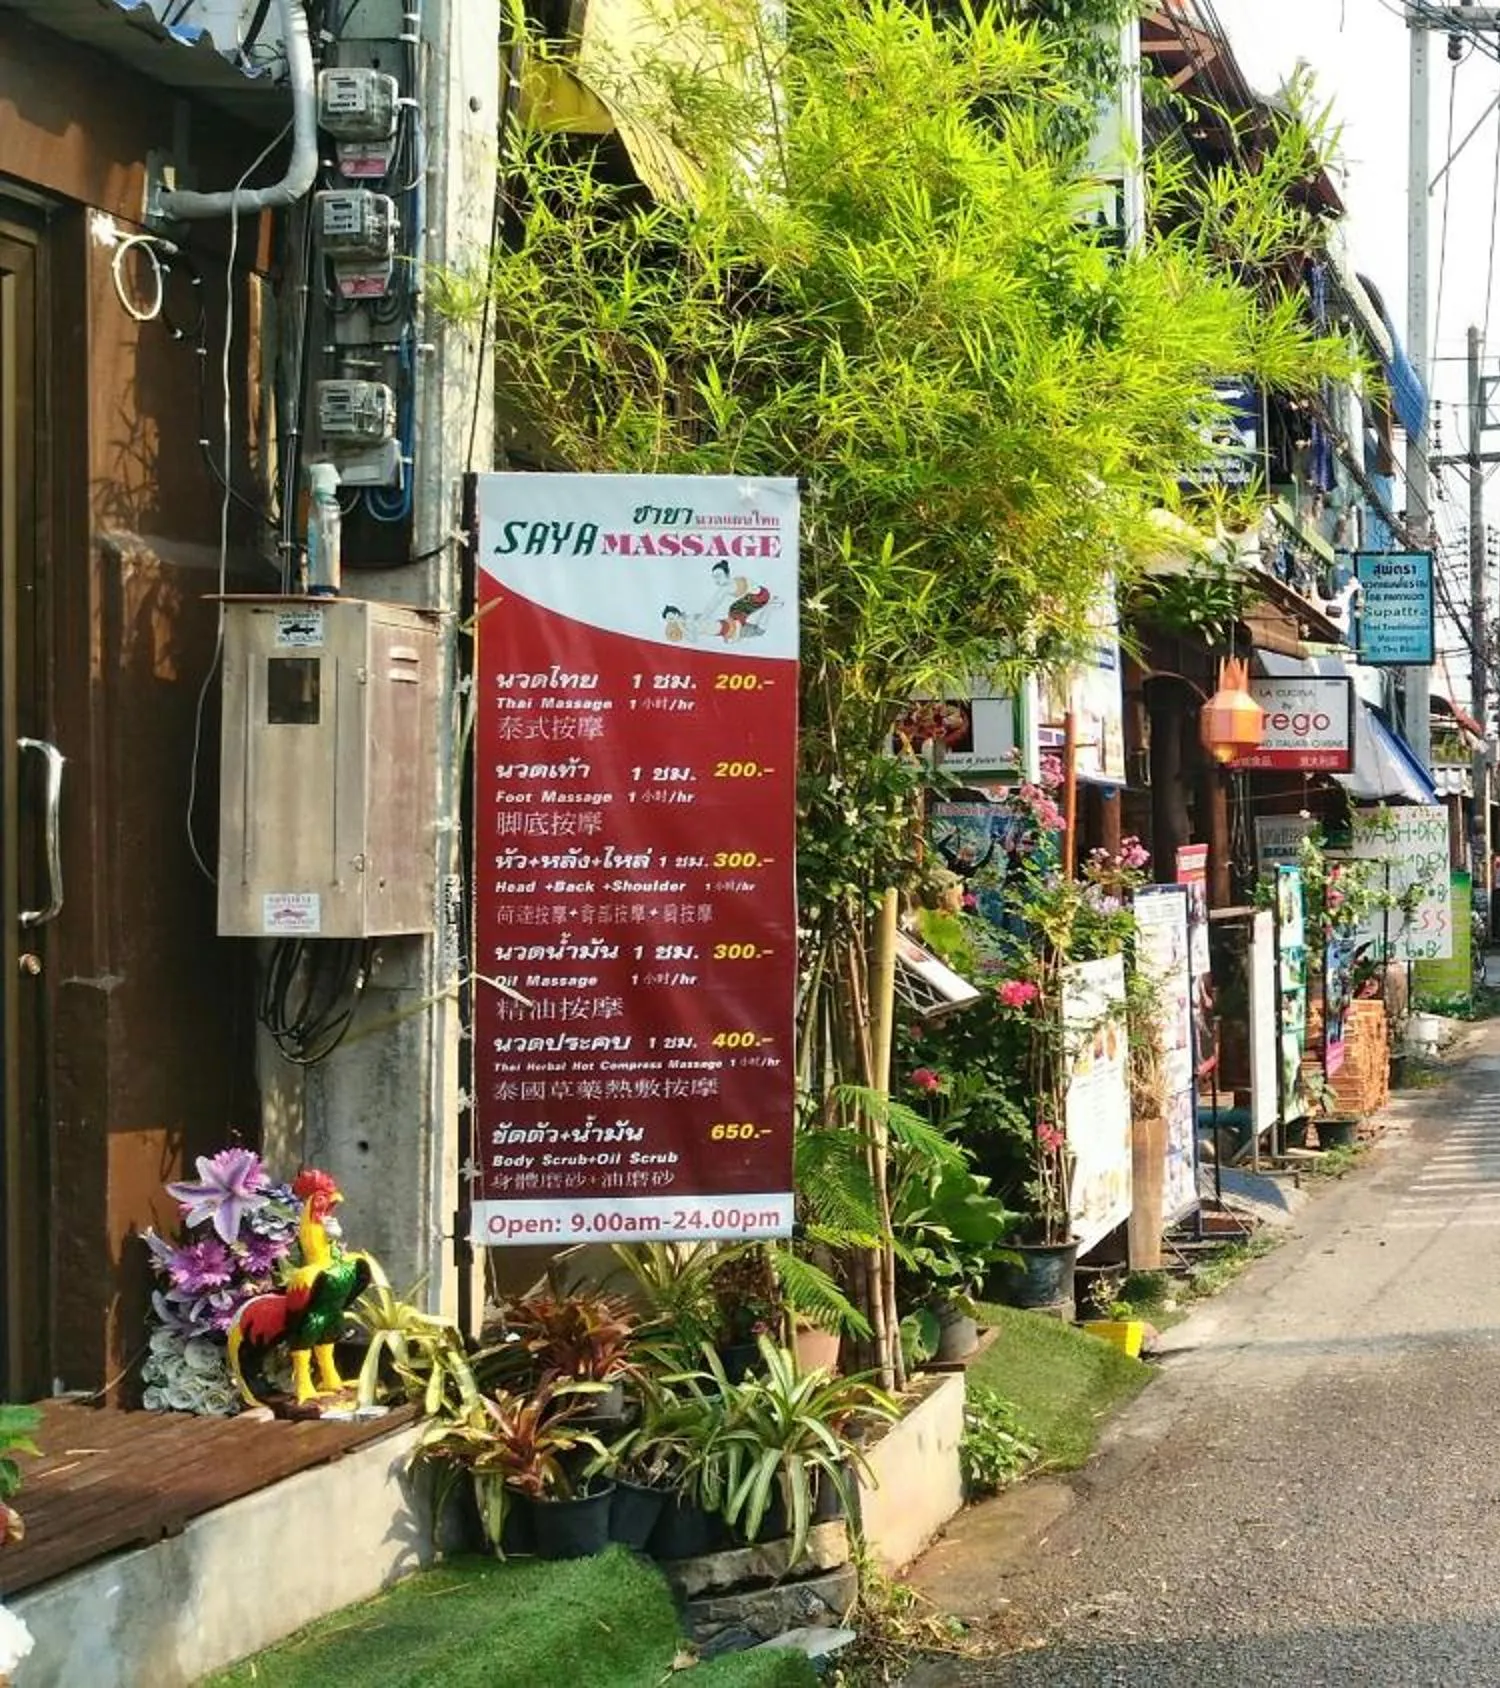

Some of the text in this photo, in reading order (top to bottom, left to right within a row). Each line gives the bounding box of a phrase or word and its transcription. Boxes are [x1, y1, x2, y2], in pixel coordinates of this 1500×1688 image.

[494, 521, 781, 558] SAYA MASSAGE
[1364, 606, 1428, 619] Supattra
[496, 665, 599, 690] นวดไทย
[632, 674, 642, 689] 1
[715, 673, 775, 690] 200.-
[1259, 689, 1272, 697] LA
[496, 697, 532, 710] Thai
[541, 697, 613, 712] Massage
[499, 715, 605, 741] 泰式按摩
[1262, 713, 1331, 737] rego
[495, 757, 591, 779] นวดเท้า
[631, 767, 642, 781] 1
[714, 761, 775, 778] 200.-
[496, 790, 532, 803] Foot
[541, 790, 613, 805] Massage
[713, 852, 775, 869] 300.-
[1263, 847, 1298, 858] BEAU
[495, 881, 536, 893] Head
[495, 932, 619, 961] นวดน้ำมัน
[634, 945, 643, 960] 1
[713, 944, 774, 960] 300.-
[495, 975, 518, 989] Oil
[526, 975, 598, 988] Massage
[496, 996, 625, 1021] 精油按摩
[494, 1032, 632, 1053] นวดประคบ
[712, 1032, 774, 1049] 400.-
[494, 1062, 521, 1072] Thai
[526, 1061, 566, 1072] Herbal
[572, 1061, 595, 1071] Hot
[600, 1060, 663, 1073] Compress
[668, 1058, 723, 1070] Massage
[711, 1123, 773, 1141] 650.-
[493, 1151, 679, 1169] Body Scrub+Oil Scrub
[488, 1208, 781, 1239] Open: 9.00am-24.00pm
